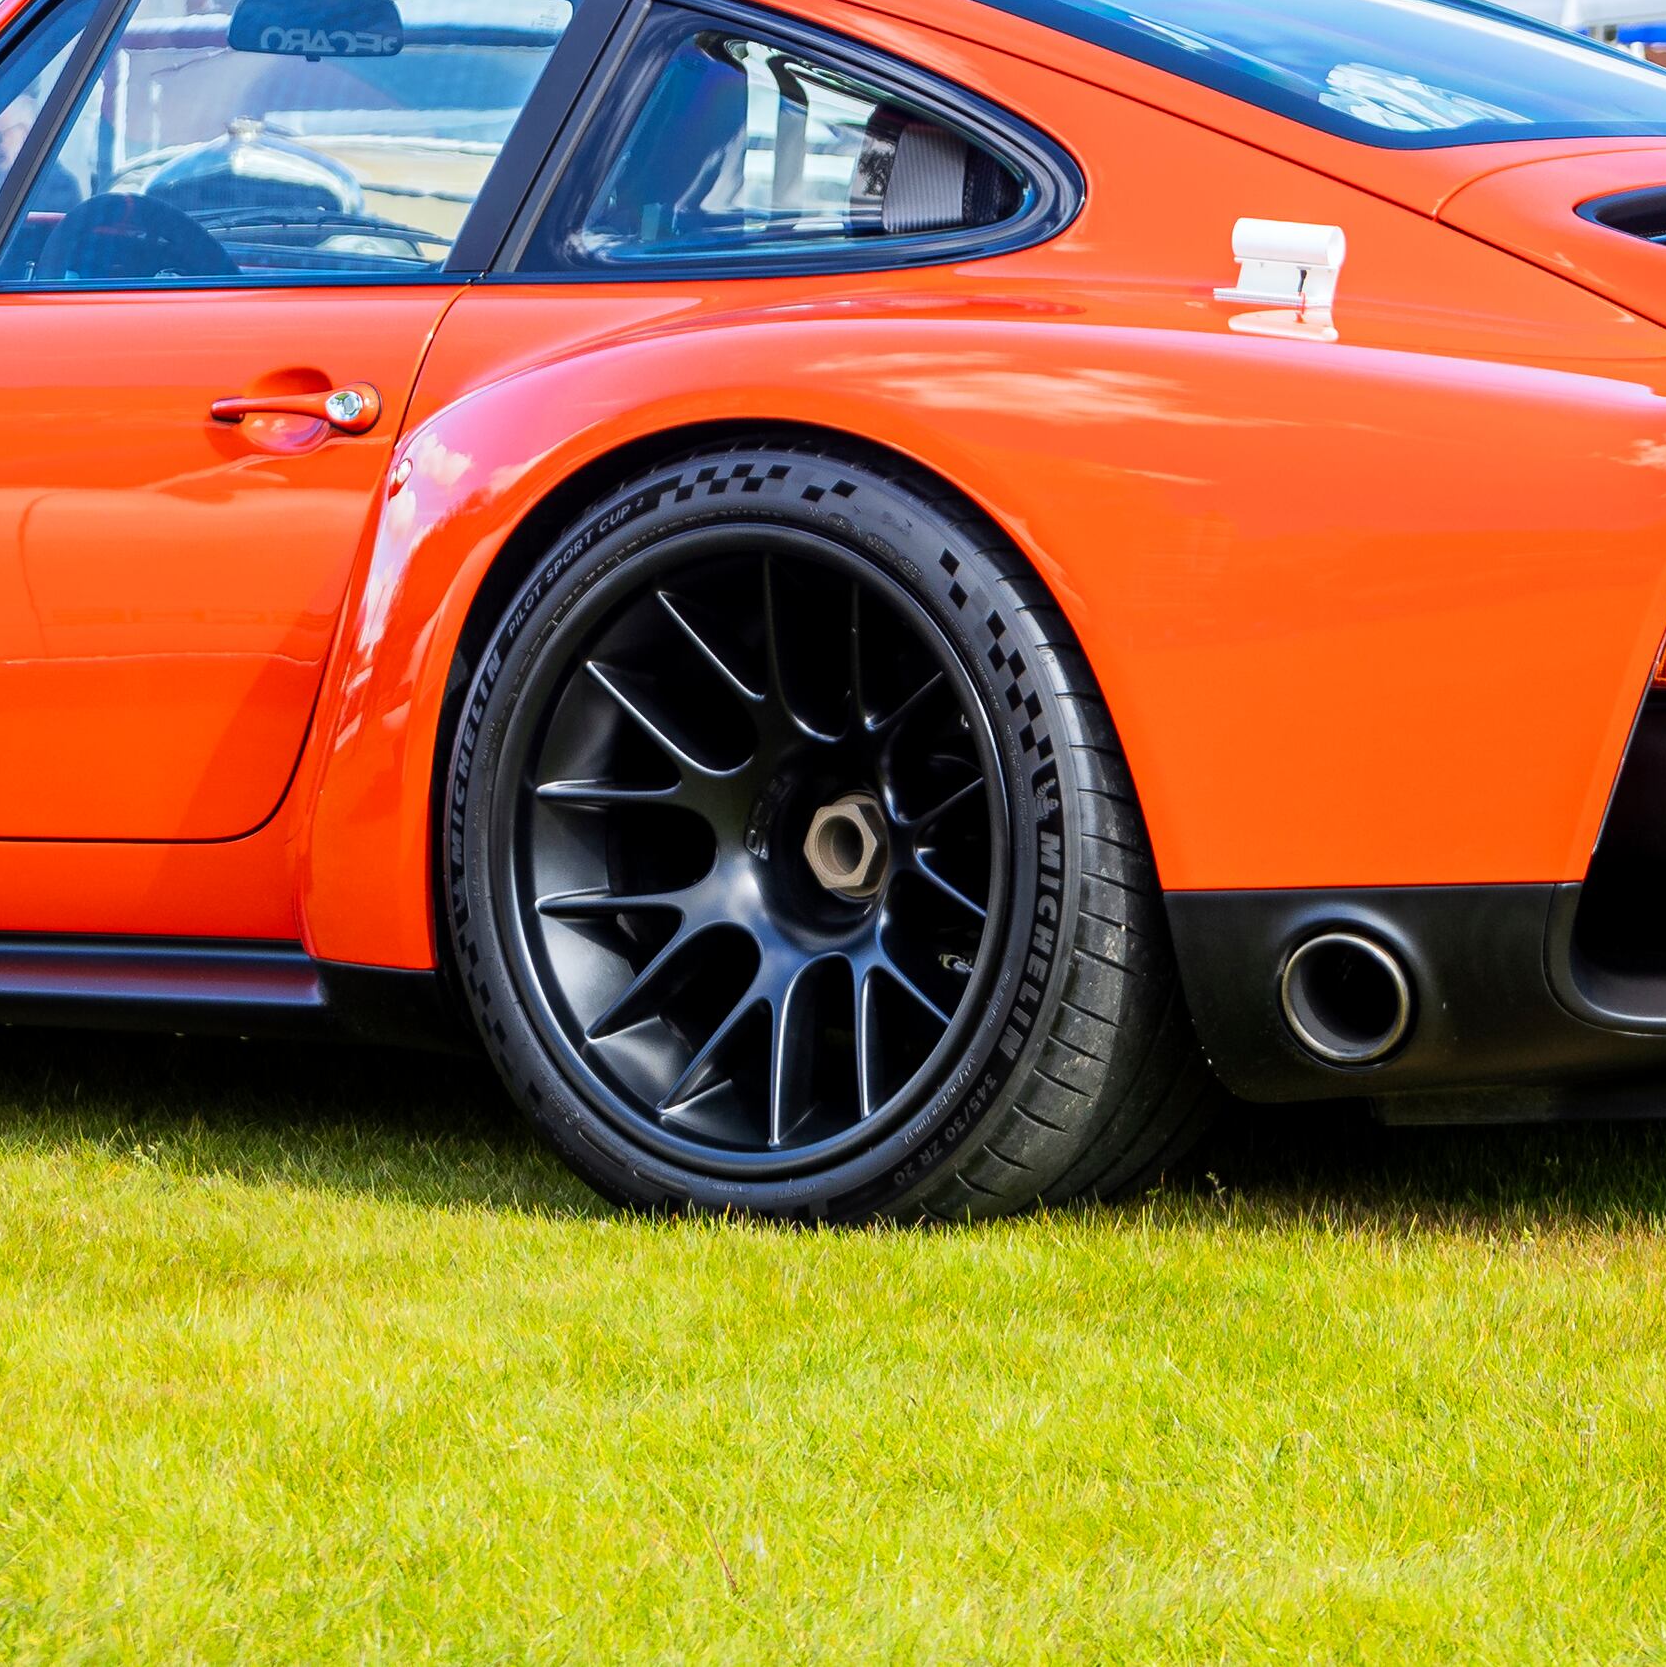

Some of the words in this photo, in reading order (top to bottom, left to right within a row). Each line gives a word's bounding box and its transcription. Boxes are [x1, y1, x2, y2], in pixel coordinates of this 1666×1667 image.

[451, 648, 502, 867] MICHELIN
[507, 581, 542, 638] PILOT
[545, 529, 594, 583] SPORT
[598, 504, 631, 533] CUP
[635, 497, 645, 508] 2
[999, 831, 1061, 1061] MICHELIN
[944, 1073, 997, 1142] 345/30
[893, 1162, 916, 1184] 20
[919, 1140, 944, 1163] ZR
